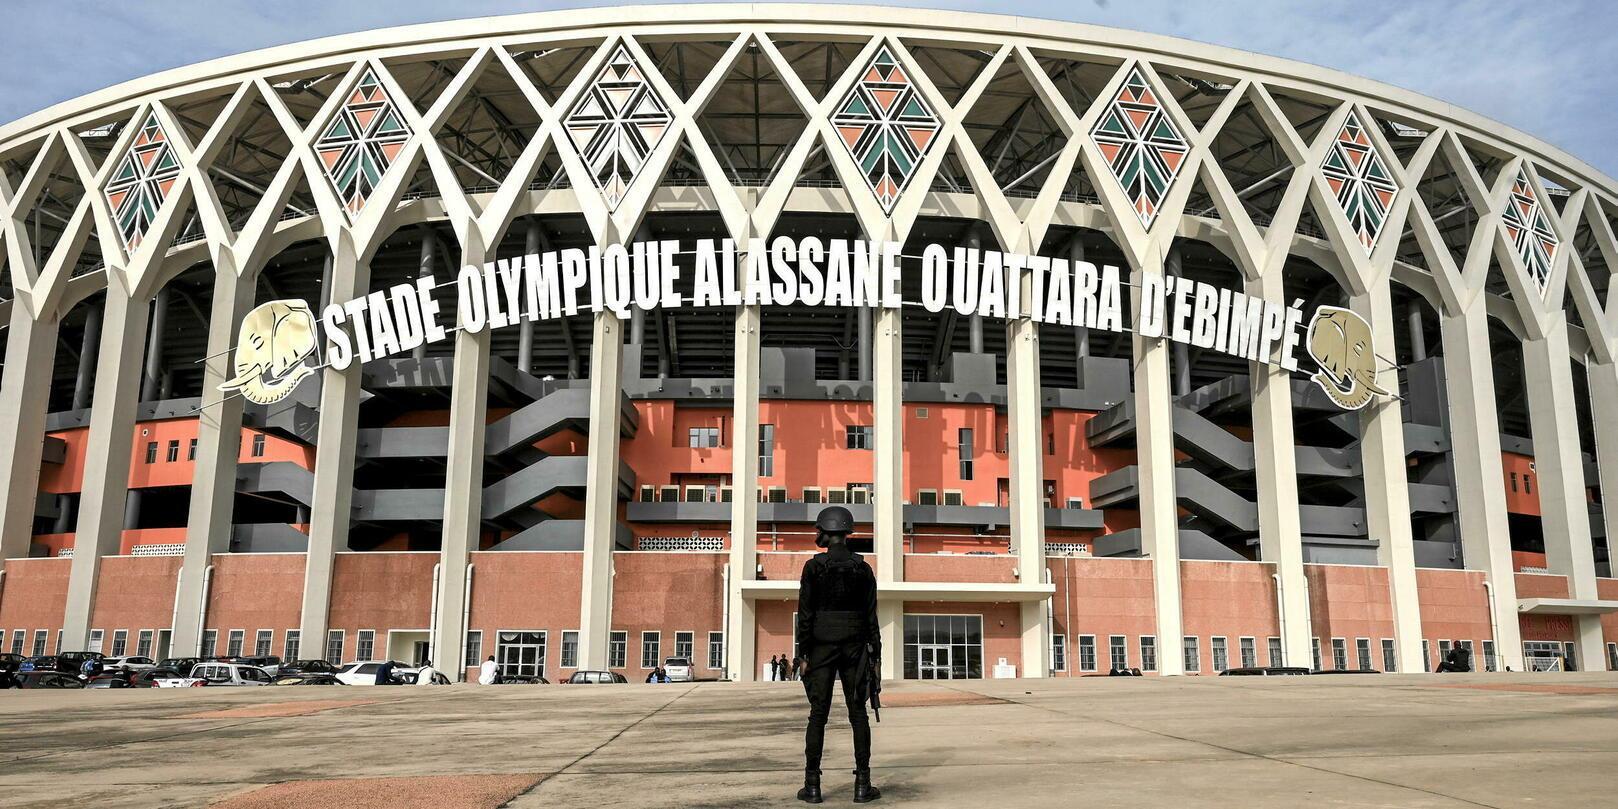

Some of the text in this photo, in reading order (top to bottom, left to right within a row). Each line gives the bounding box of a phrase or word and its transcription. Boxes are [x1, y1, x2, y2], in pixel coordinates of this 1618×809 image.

[322, 236, 1304, 373] STADE OLYMPIQUE ALASSANE OUATTARA D'EBIMPÉ
